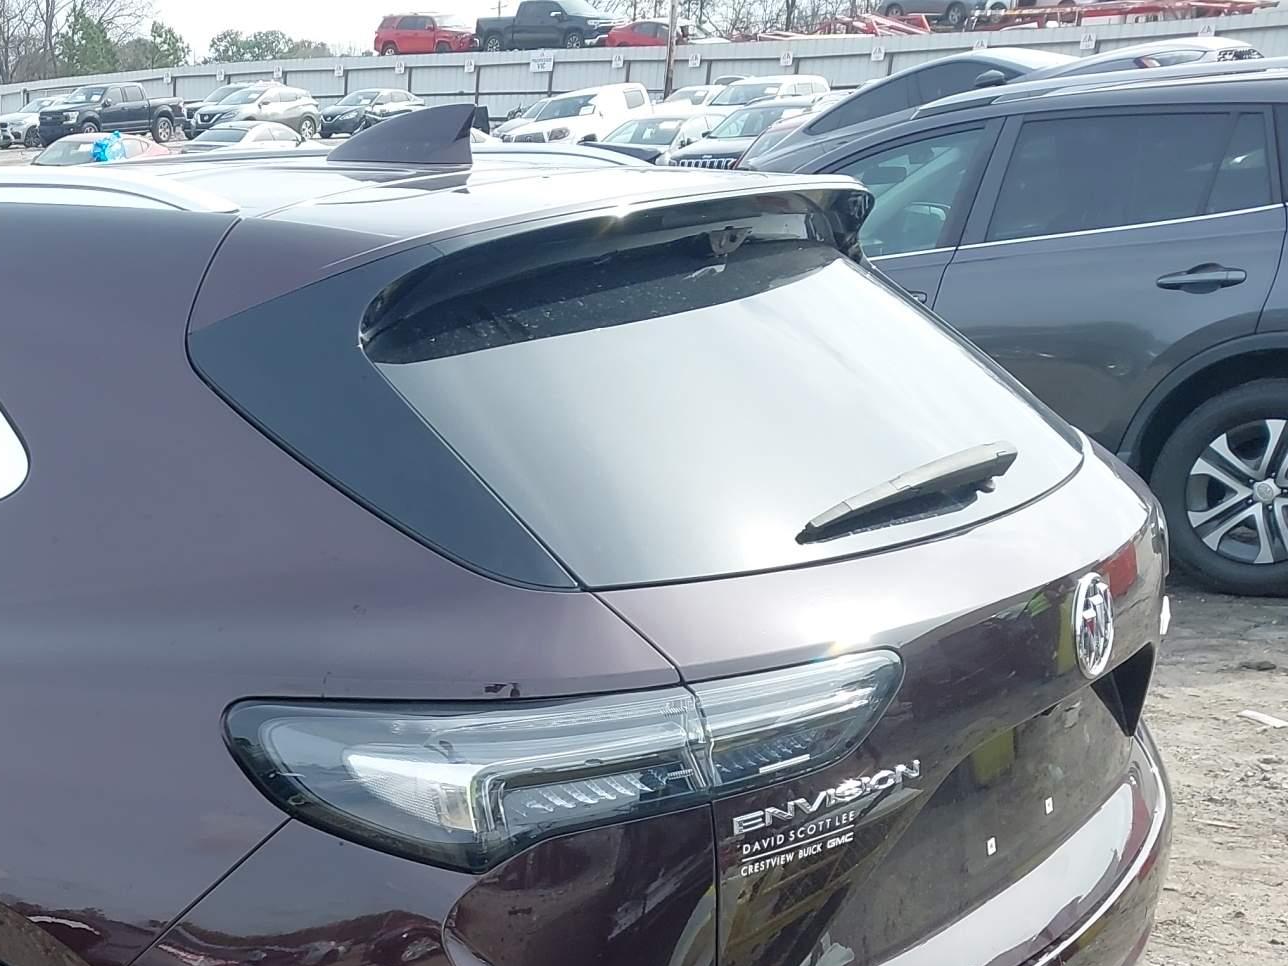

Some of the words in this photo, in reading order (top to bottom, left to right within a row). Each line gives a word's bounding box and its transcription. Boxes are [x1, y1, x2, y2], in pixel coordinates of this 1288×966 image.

[732, 759, 921, 836] ENVISION
[740, 852, 795, 877] CRESTVIEW
[798, 843, 822, 859] BUICK
[826, 831, 855, 849] GMC
[742, 834, 785, 855] DAVID
[789, 818, 831, 842] SCOTT
[834, 810, 856, 828] LEE
